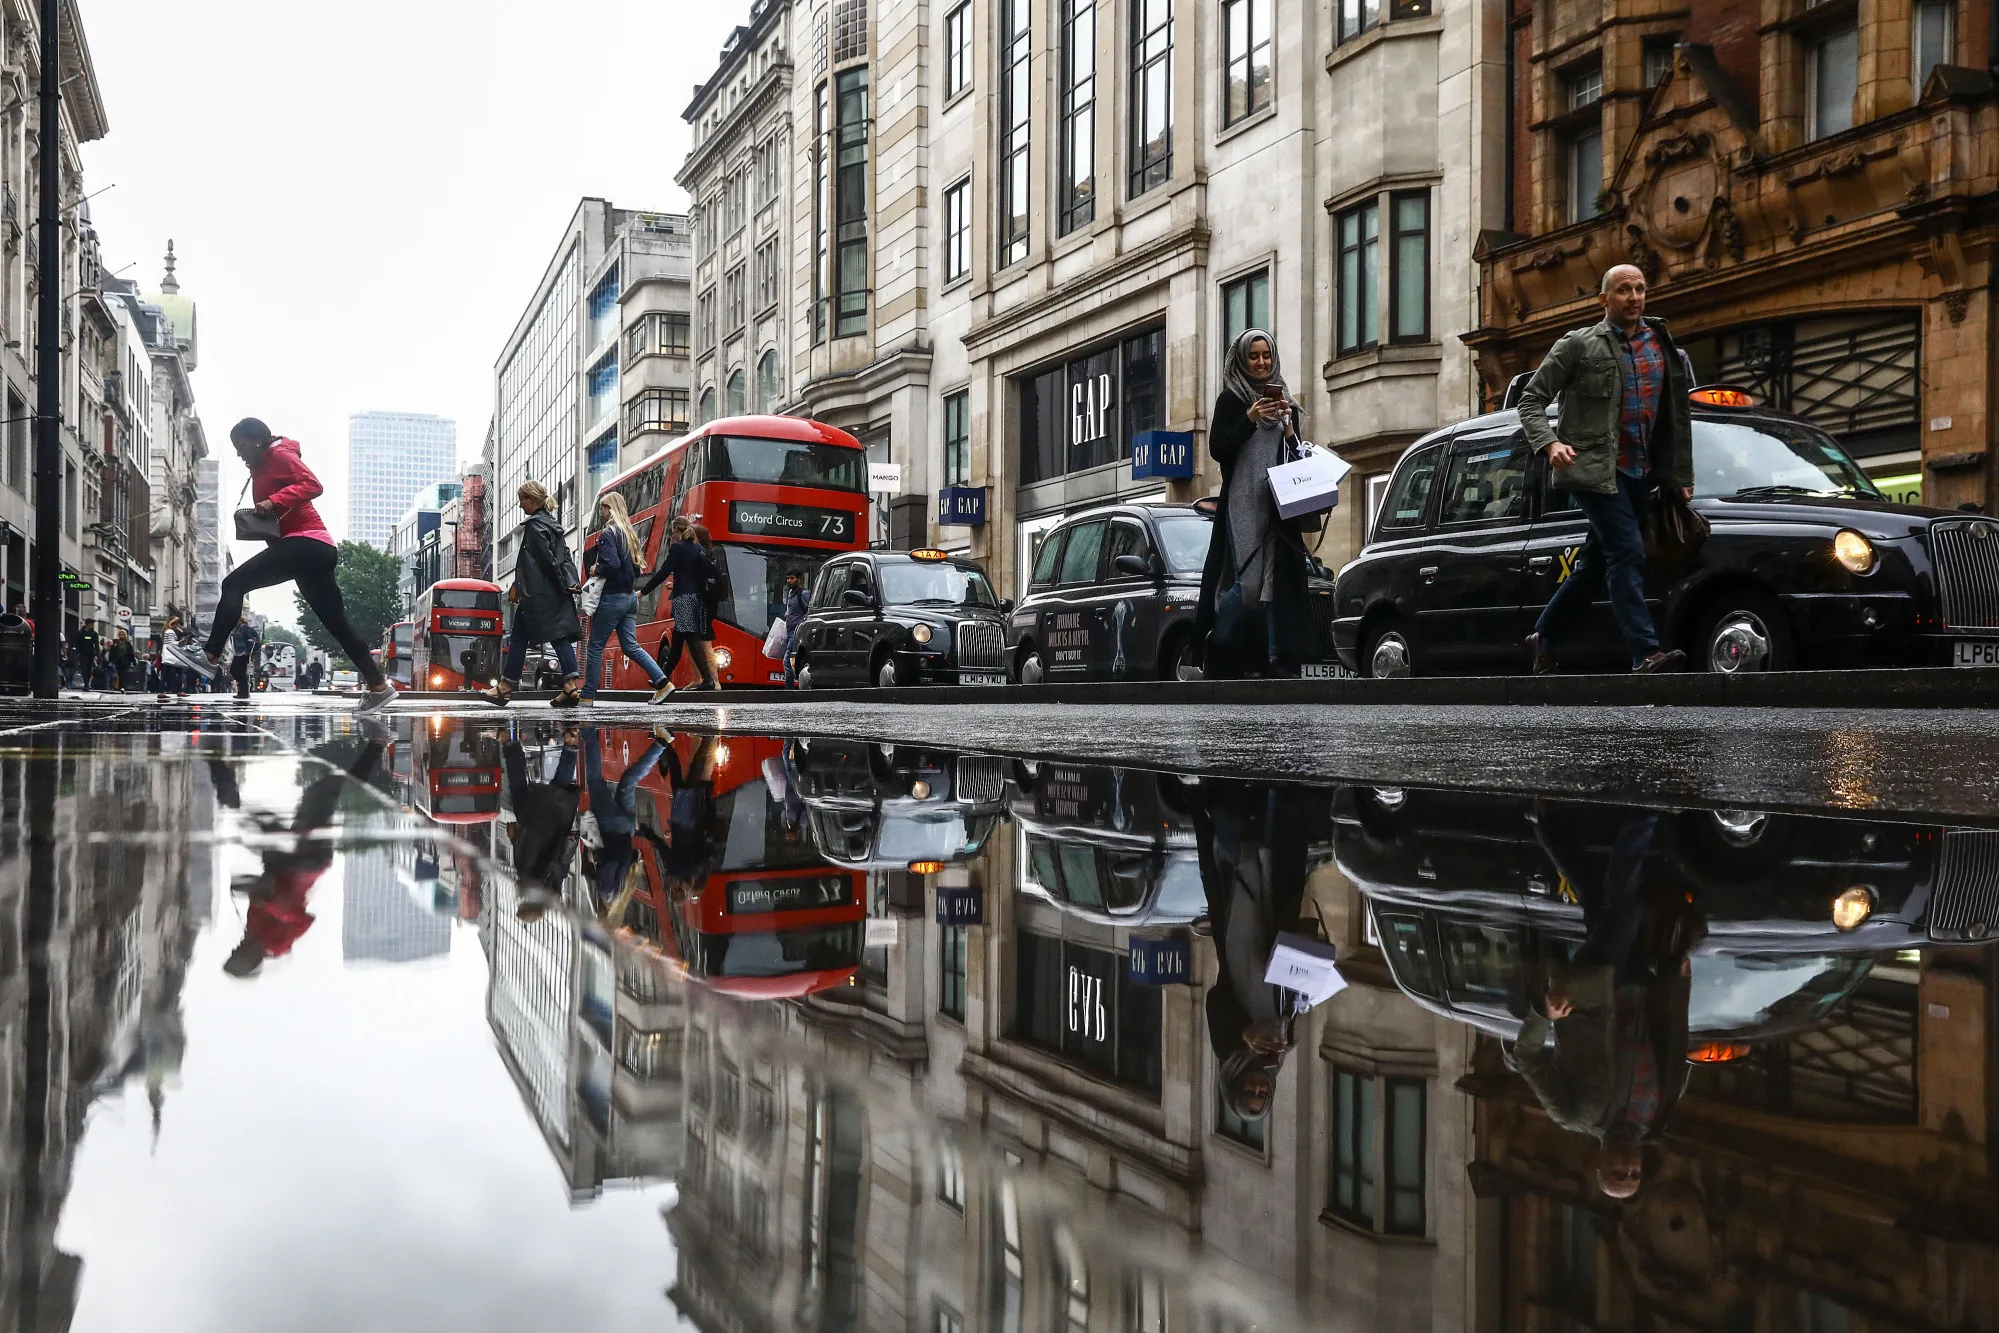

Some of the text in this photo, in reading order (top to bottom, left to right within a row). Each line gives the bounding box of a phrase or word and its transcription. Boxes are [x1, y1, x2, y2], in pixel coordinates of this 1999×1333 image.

[1072, 373, 1110, 446] GAP
[1135, 444, 1149, 467] GAP
[1160, 443, 1185, 466] GAP
[1292, 476, 1312, 485] Dior
[958, 497, 979, 515] GAP
[740, 512, 845, 535] Oxford Circus 73
[480, 620, 491, 629] 390
[1305, 665, 1336, 677] LL58
